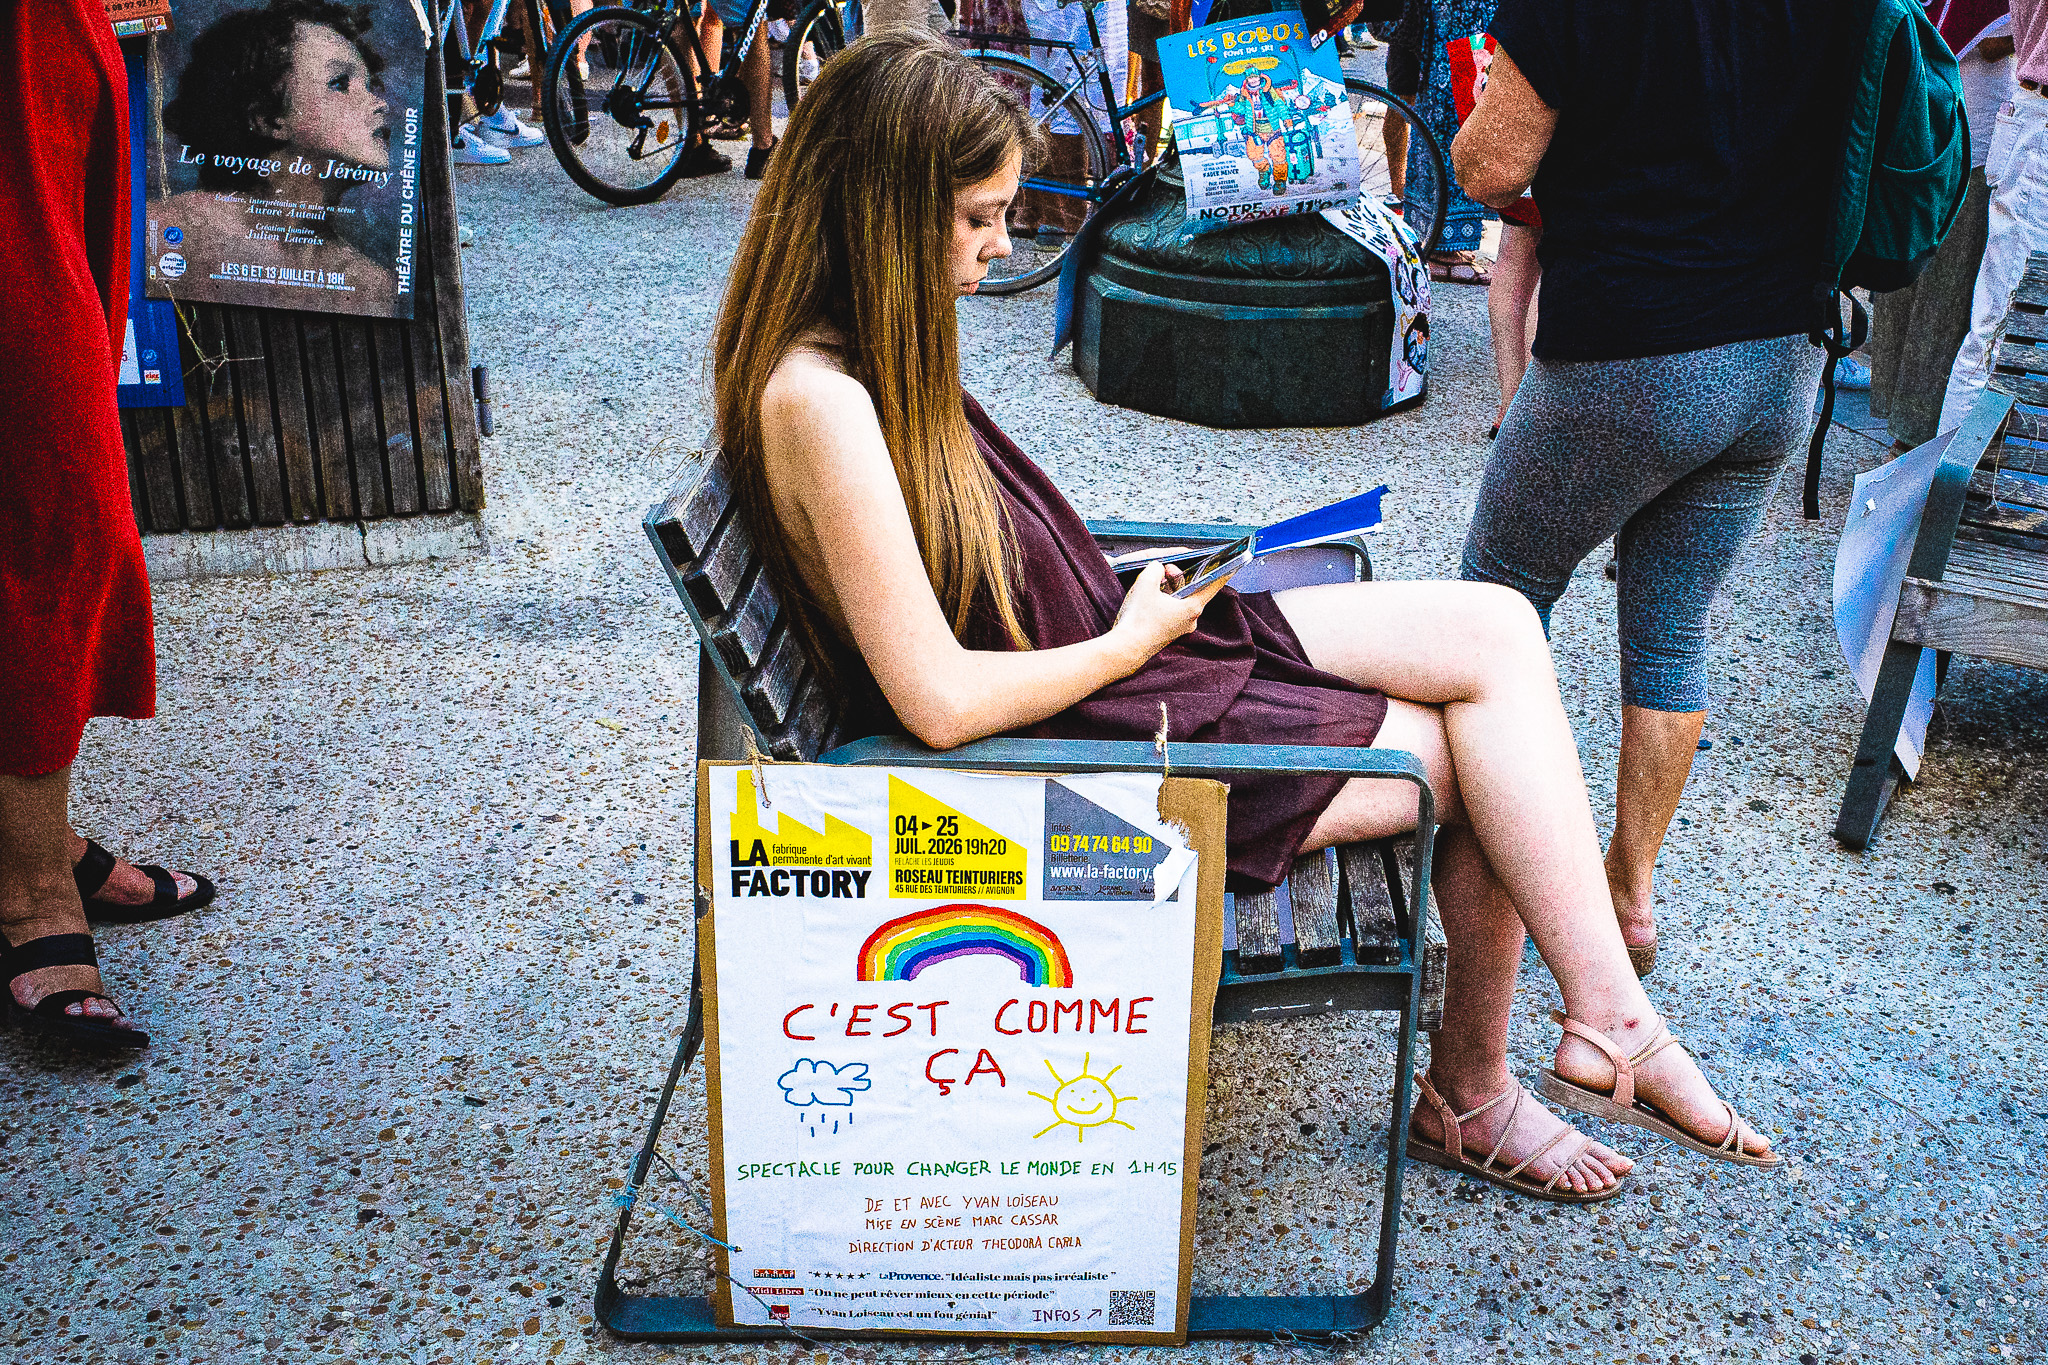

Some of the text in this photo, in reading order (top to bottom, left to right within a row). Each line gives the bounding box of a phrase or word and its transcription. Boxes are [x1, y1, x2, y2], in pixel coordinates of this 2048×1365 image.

[1187, 38, 1217, 58] LES
[1222, 23, 1304, 50] BOBOS
[177, 144, 394, 189] Le voyage de Jérémy
[395, 107, 418, 295] THÉÂTRE DU CHÊNE NOIR
[245, 204, 326, 220] Aurore Auteuil
[1200, 202, 1262, 220] NOTRE
[1228, 207, 1290, 222] DAME
[255, 222, 286, 232] Création
[245, 229, 324, 246] Julien Lacroix
[221, 262, 240, 276] LES
[242, 264, 248, 276] 6
[251, 265, 264, 278] ET
[265, 266, 276, 279] 13
[278, 267, 316, 282] JUILLET
[318, 268, 325, 284] À
[326, 272, 345, 286] 18H
[895, 815, 958, 836] 04 25
[1051, 823, 1072, 832] Infos
[772, 844, 807, 856] fabrique
[894, 838, 1006, 856] JUIL. 2026 19h20
[1050, 834, 1153, 854] 09 74 74 64 90
[730, 839, 770, 867] LA
[772, 854, 872, 866] permanente d'art vivant
[1050, 853, 1089, 863] Billetterie
[922, 858, 932, 866] LES
[932, 858, 954, 866] JEUDIS
[895, 869, 1024, 885] ROSEAU TEINTURIERS
[1050, 864, 1154, 882] www.la-factory.
[730, 869, 872, 898] FACTORY
[894, 884, 904, 894] 45
[906, 884, 918, 894] RUE
[920, 885, 932, 894] DES
[934, 885, 976, 894] TEINTURIERS
[986, 886, 1015, 895] AVIGNON
[782, 996, 1154, 1041] C'EST COMME
[924, 1048, 1006, 1096] ÇA
[738, 1160, 1178, 1180] SPECTACLE POUR CHANGER LE MONDE EN 1H15
[864, 1197, 884, 1214] DE
[894, 1196, 912, 1212] ET
[920, 1196, 952, 1210] AVEC
[962, 1195, 1000, 1209] YVAN
[900, 1218, 917, 1230] EN
[924, 1215, 962, 1229] SCÈNE
[972, 1215, 1003, 1227] MARC
[1010, 1214, 1059, 1226] CASSAR
[920, 1238, 974, 1252] D'ACTEUR
[982, 1236, 1042, 1250] THEODORA
[1048, 1236, 1082, 1249] CARLA
[946, 1272, 1000, 1282] "Idéaliste
[1002, 1272, 1030, 1282] mais
[1032, 1274, 1053, 1284] pas
[1054, 1272, 1109, 1282] irréaliste
[808, 1288, 1054, 1302] "On ne peut rêver mieux en cette période"
[811, 1307, 998, 1322] "Yvan Loiseau est un fou génial"
[1032, 1309, 1080, 1323] INFOS
